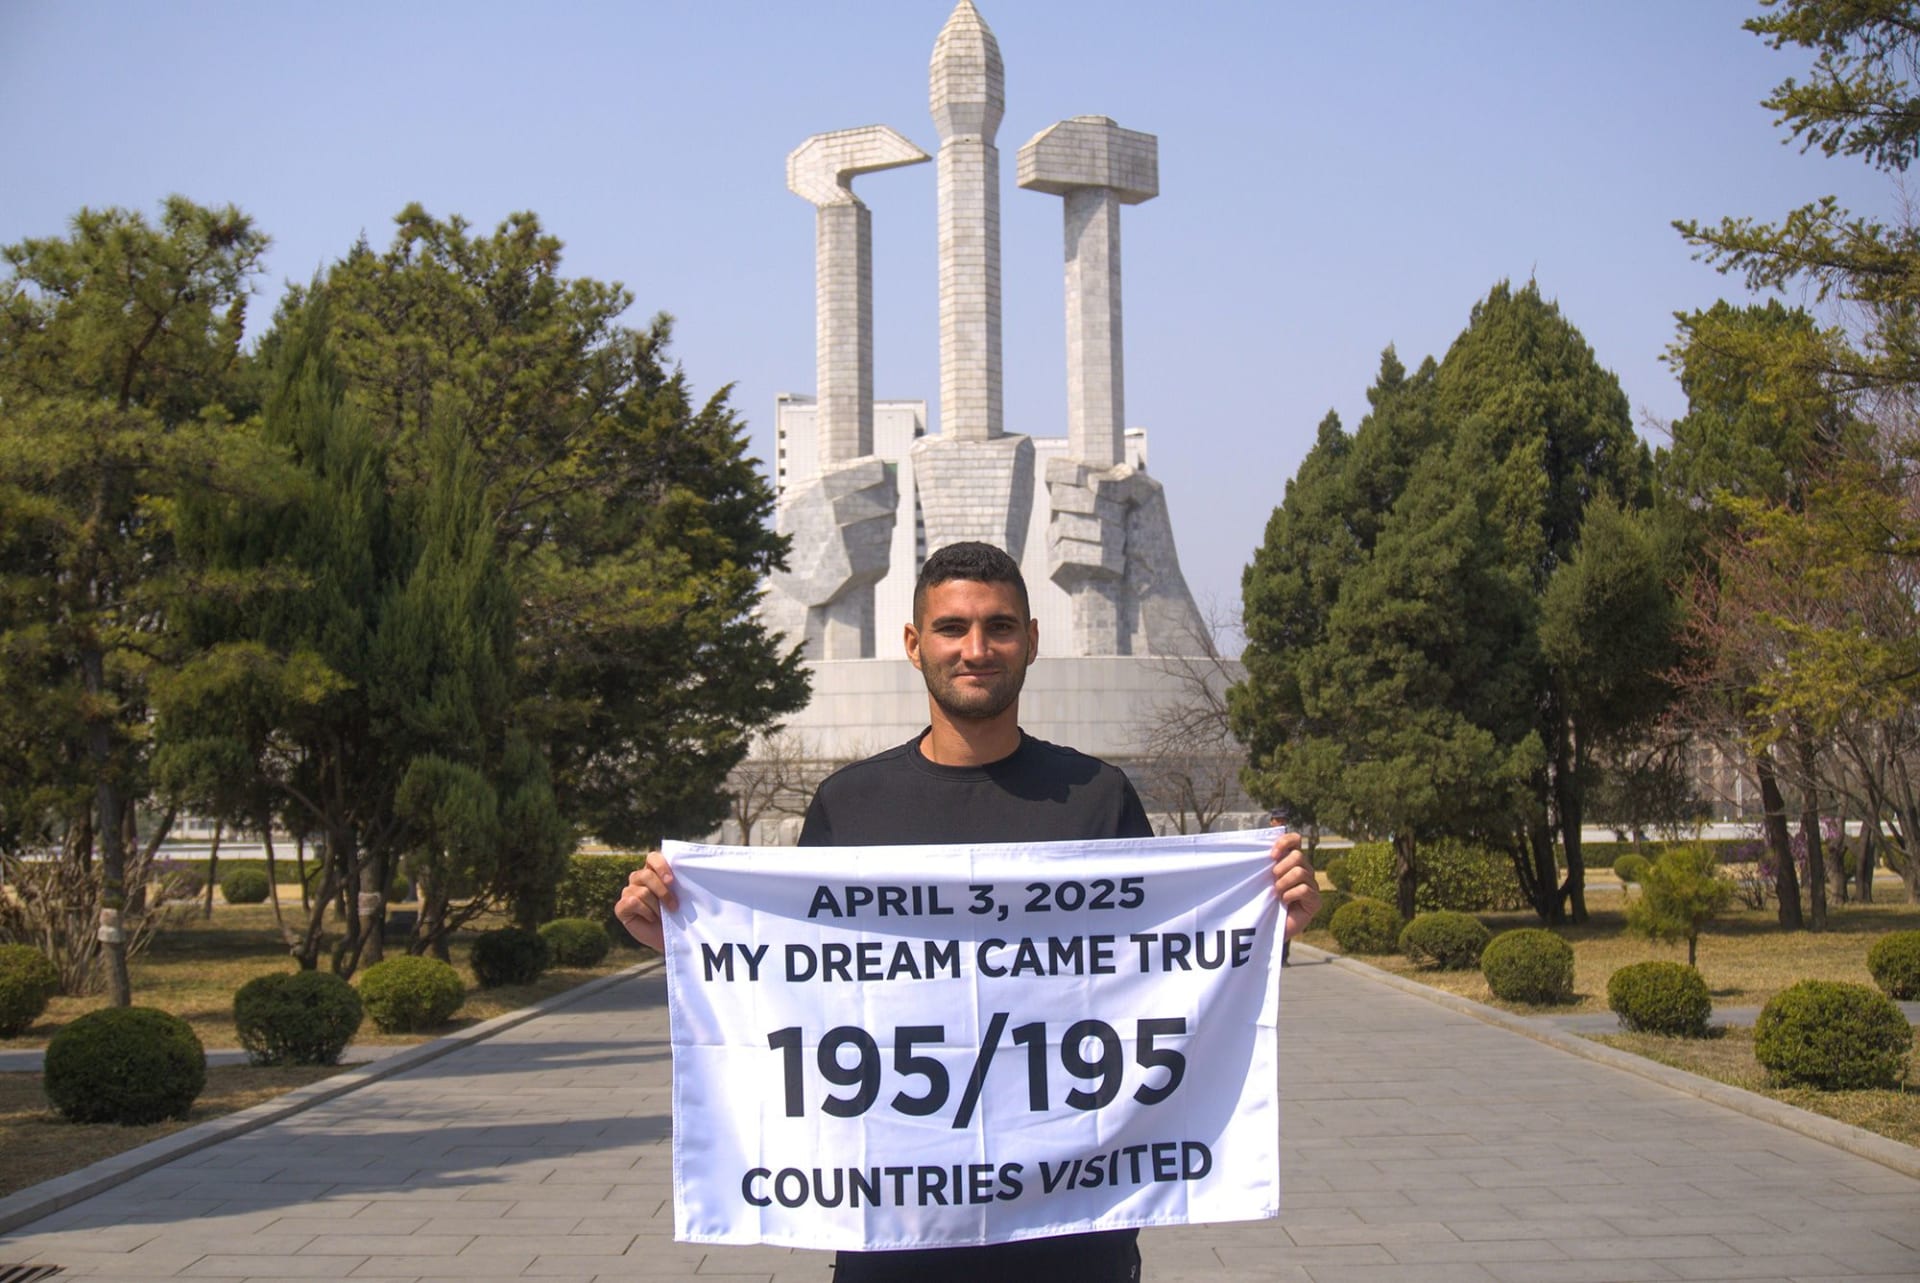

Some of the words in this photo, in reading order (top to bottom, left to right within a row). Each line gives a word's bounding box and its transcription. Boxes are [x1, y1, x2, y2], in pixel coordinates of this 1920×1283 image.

[807, 885, 955, 919] APRIL
[967, 884, 1009, 922] 3,
[1024, 876, 1145, 913] 2025
[701, 943, 769, 982] MY
[785, 939, 961, 982] DREAM
[976, 934, 1116, 978] CAME
[1129, 927, 1257, 973] TRUE
[767, 1012, 1188, 1130] 195/195
[740, 1162, 1024, 1208] COUNTRIES
[1037, 1141, 1213, 1195] VISITED
